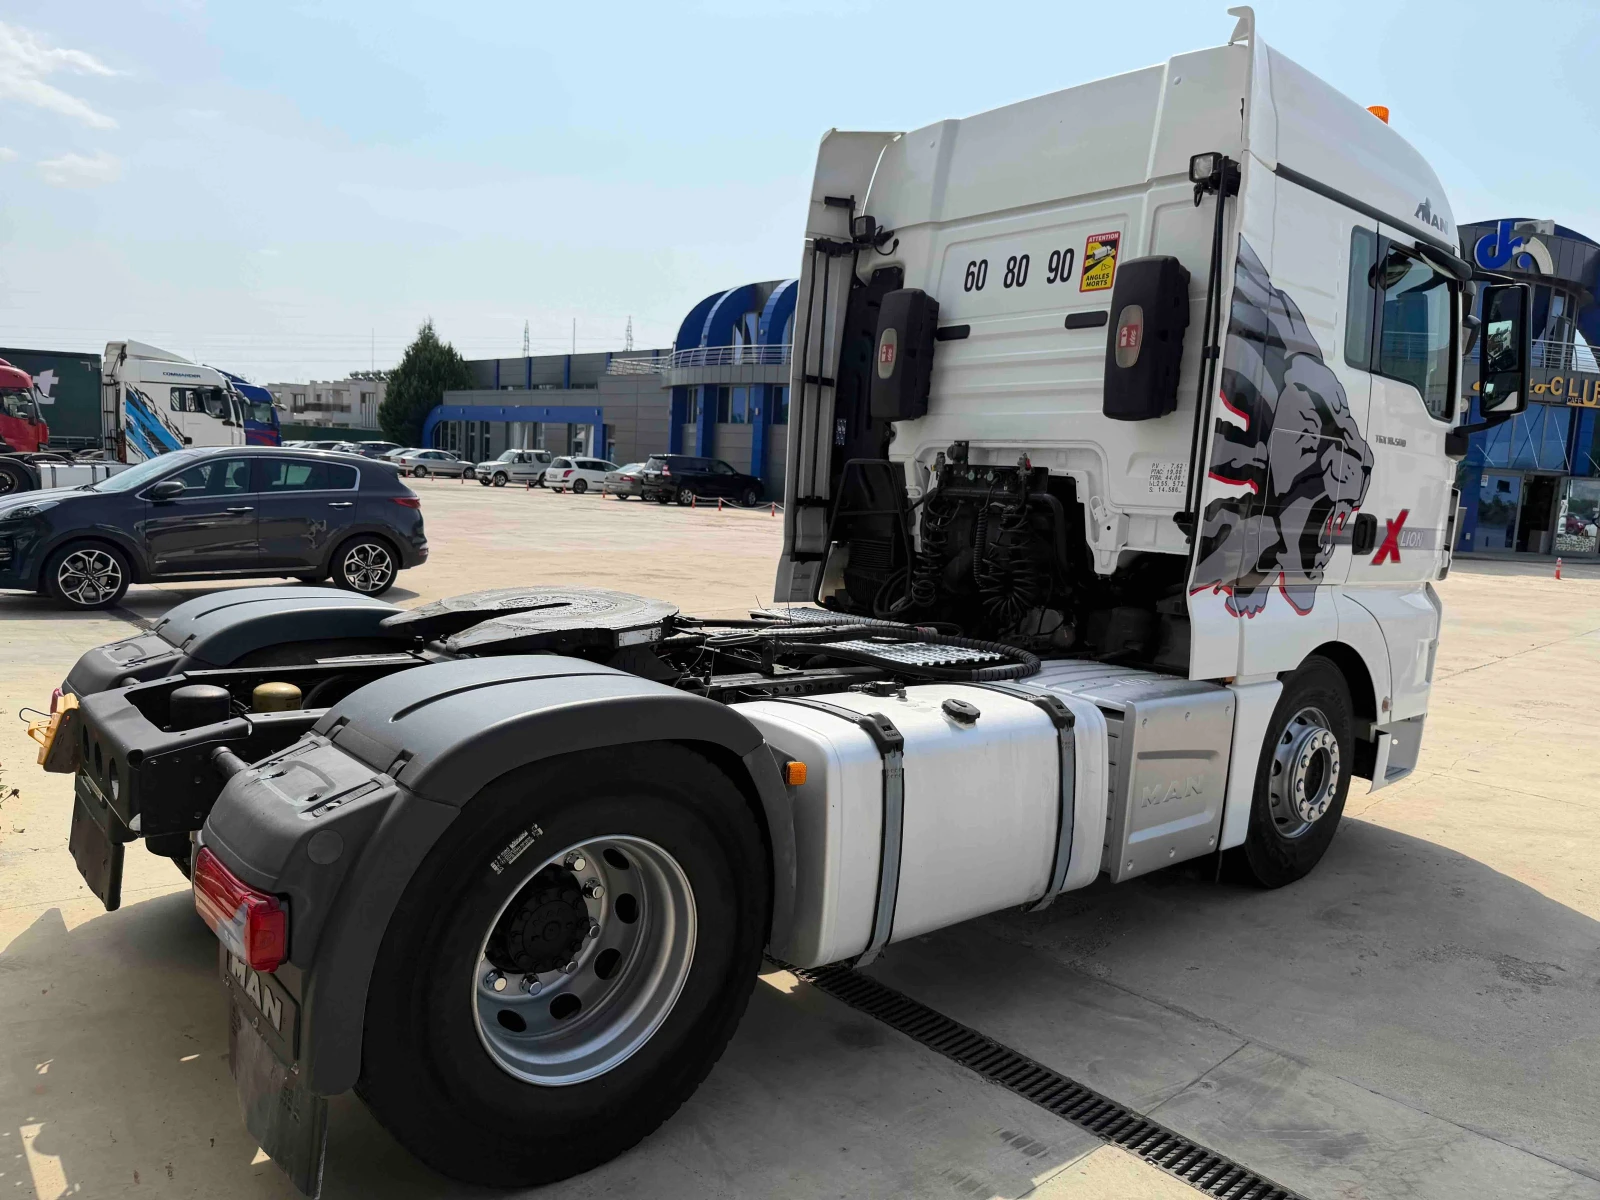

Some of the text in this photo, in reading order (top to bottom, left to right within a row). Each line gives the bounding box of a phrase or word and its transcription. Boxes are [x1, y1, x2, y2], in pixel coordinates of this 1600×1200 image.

[1414, 198, 1448, 235] MAN
[1088, 232, 1119, 243] ATTENTION
[964, 248, 1075, 292] 60 80 90
[1085, 273, 1110, 282] ANGLES
[1085, 279, 1108, 288] MORTS
[162, 371, 201, 379] COMMANDER
[1551, 376, 1600, 406] CLU
[1370, 508, 1424, 566] X LION
[1141, 775, 1204, 808] MAN
[231, 954, 283, 1032] MAN
